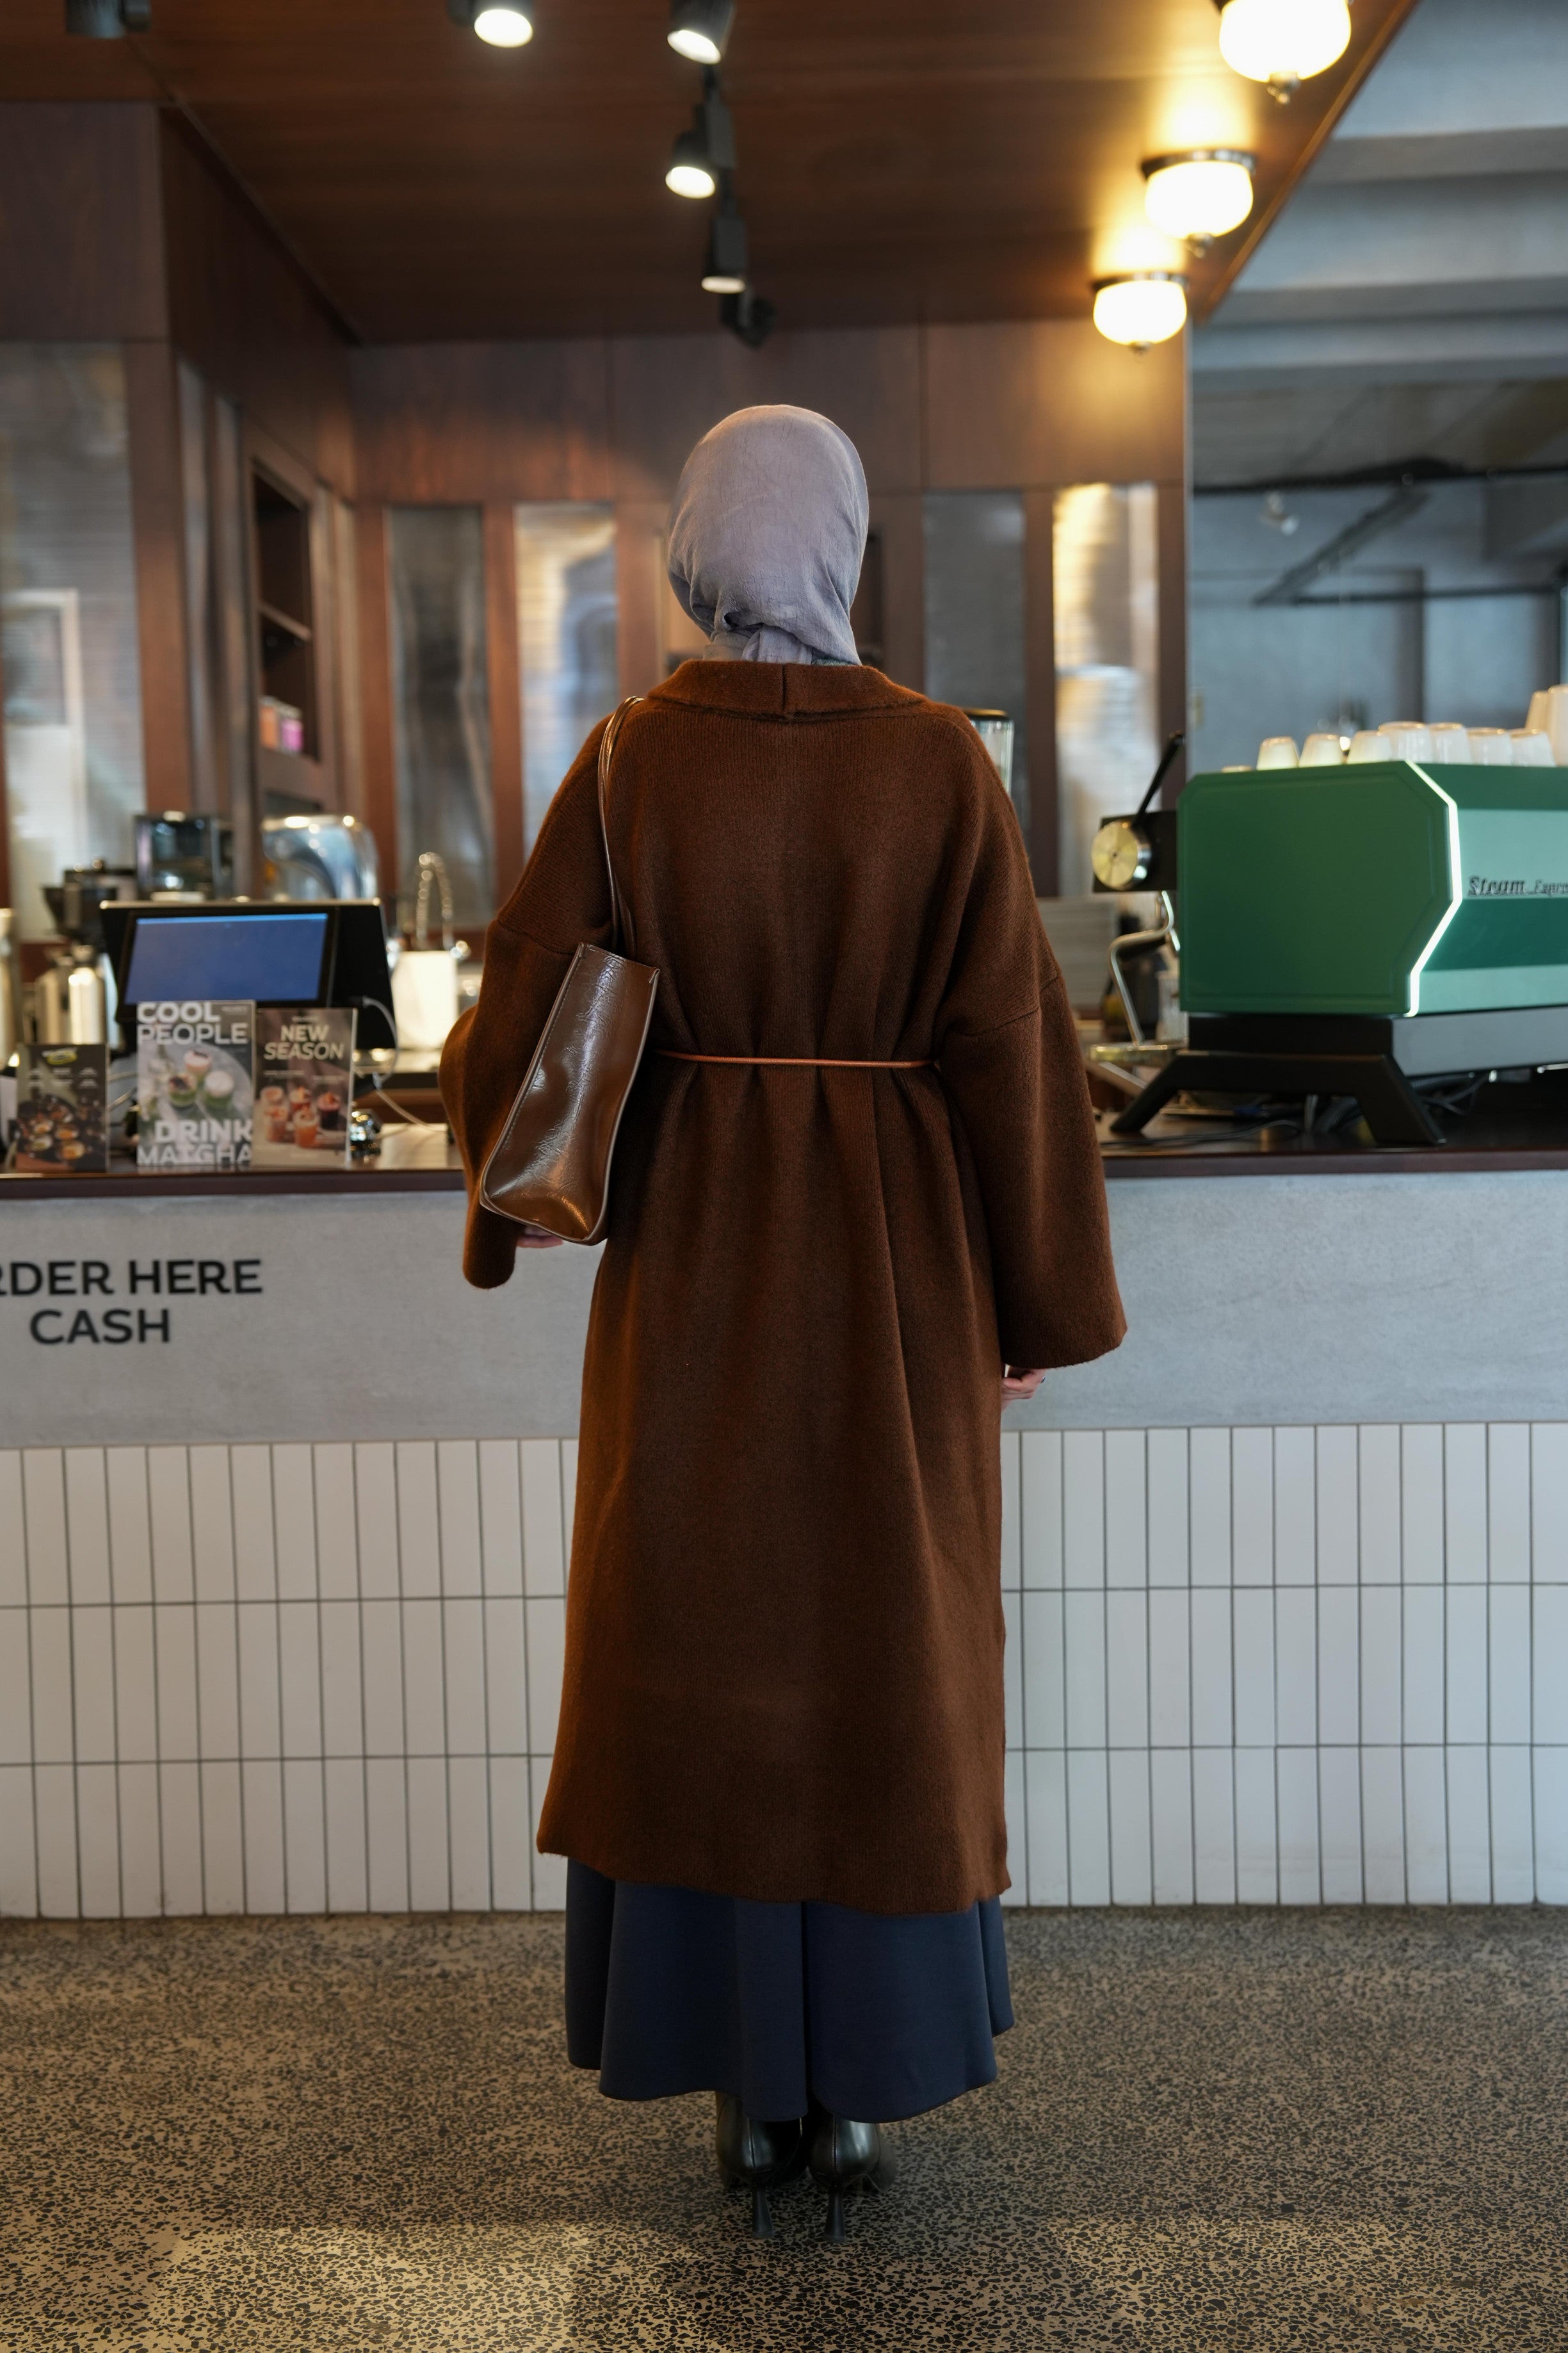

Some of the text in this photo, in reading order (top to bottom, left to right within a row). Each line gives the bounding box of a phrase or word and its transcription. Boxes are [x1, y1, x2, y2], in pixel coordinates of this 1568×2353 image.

[1469, 875, 1525, 895] Steam
[138, 1002, 220, 1023] COOL
[138, 1023, 248, 1045] PEOPLE
[280, 1025, 329, 1041] NEW
[263, 1042, 344, 1060] SEASON
[155, 1120, 252, 1143] DRINK
[0, 1260, 263, 1296] DER HERE
[29, 1308, 170, 1344] CASH
